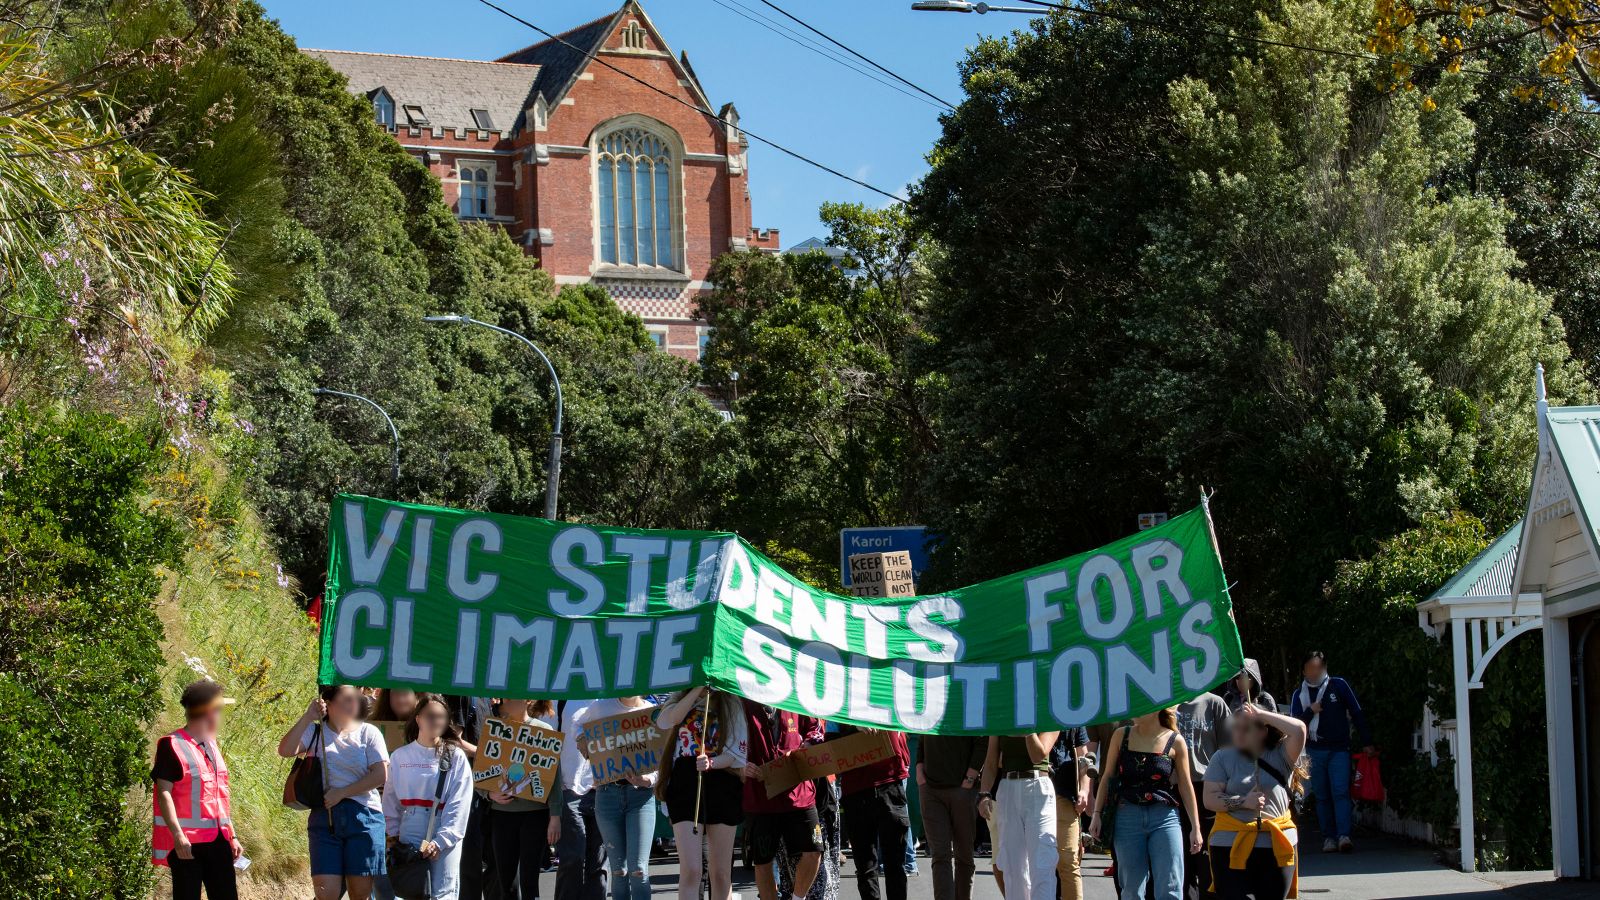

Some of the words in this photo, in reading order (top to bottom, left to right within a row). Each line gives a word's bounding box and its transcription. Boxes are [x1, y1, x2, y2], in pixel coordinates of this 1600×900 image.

[851, 535, 893, 548] Karori
[851, 556, 882, 571] KEEP
[885, 555, 907, 567] THE
[344, 501, 503, 601] VIC
[547, 527, 966, 663] STUDENTS
[1024, 538, 1191, 653] FOR
[852, 571, 882, 585] WORLD
[885, 569, 911, 581] CLEAN
[856, 585, 879, 596] IT'S
[892, 582, 911, 594] NOT
[333, 589, 698, 691] CLIMATE
[735, 600, 1221, 731] SOLUTIONS
[584, 719, 619, 739] KEEP
[621, 715, 651, 730] OUR
[587, 727, 661, 754] CLEANER
[617, 742, 647, 754] THAN
[807, 751, 833, 767] OUR
[836, 747, 885, 770] PLANET
